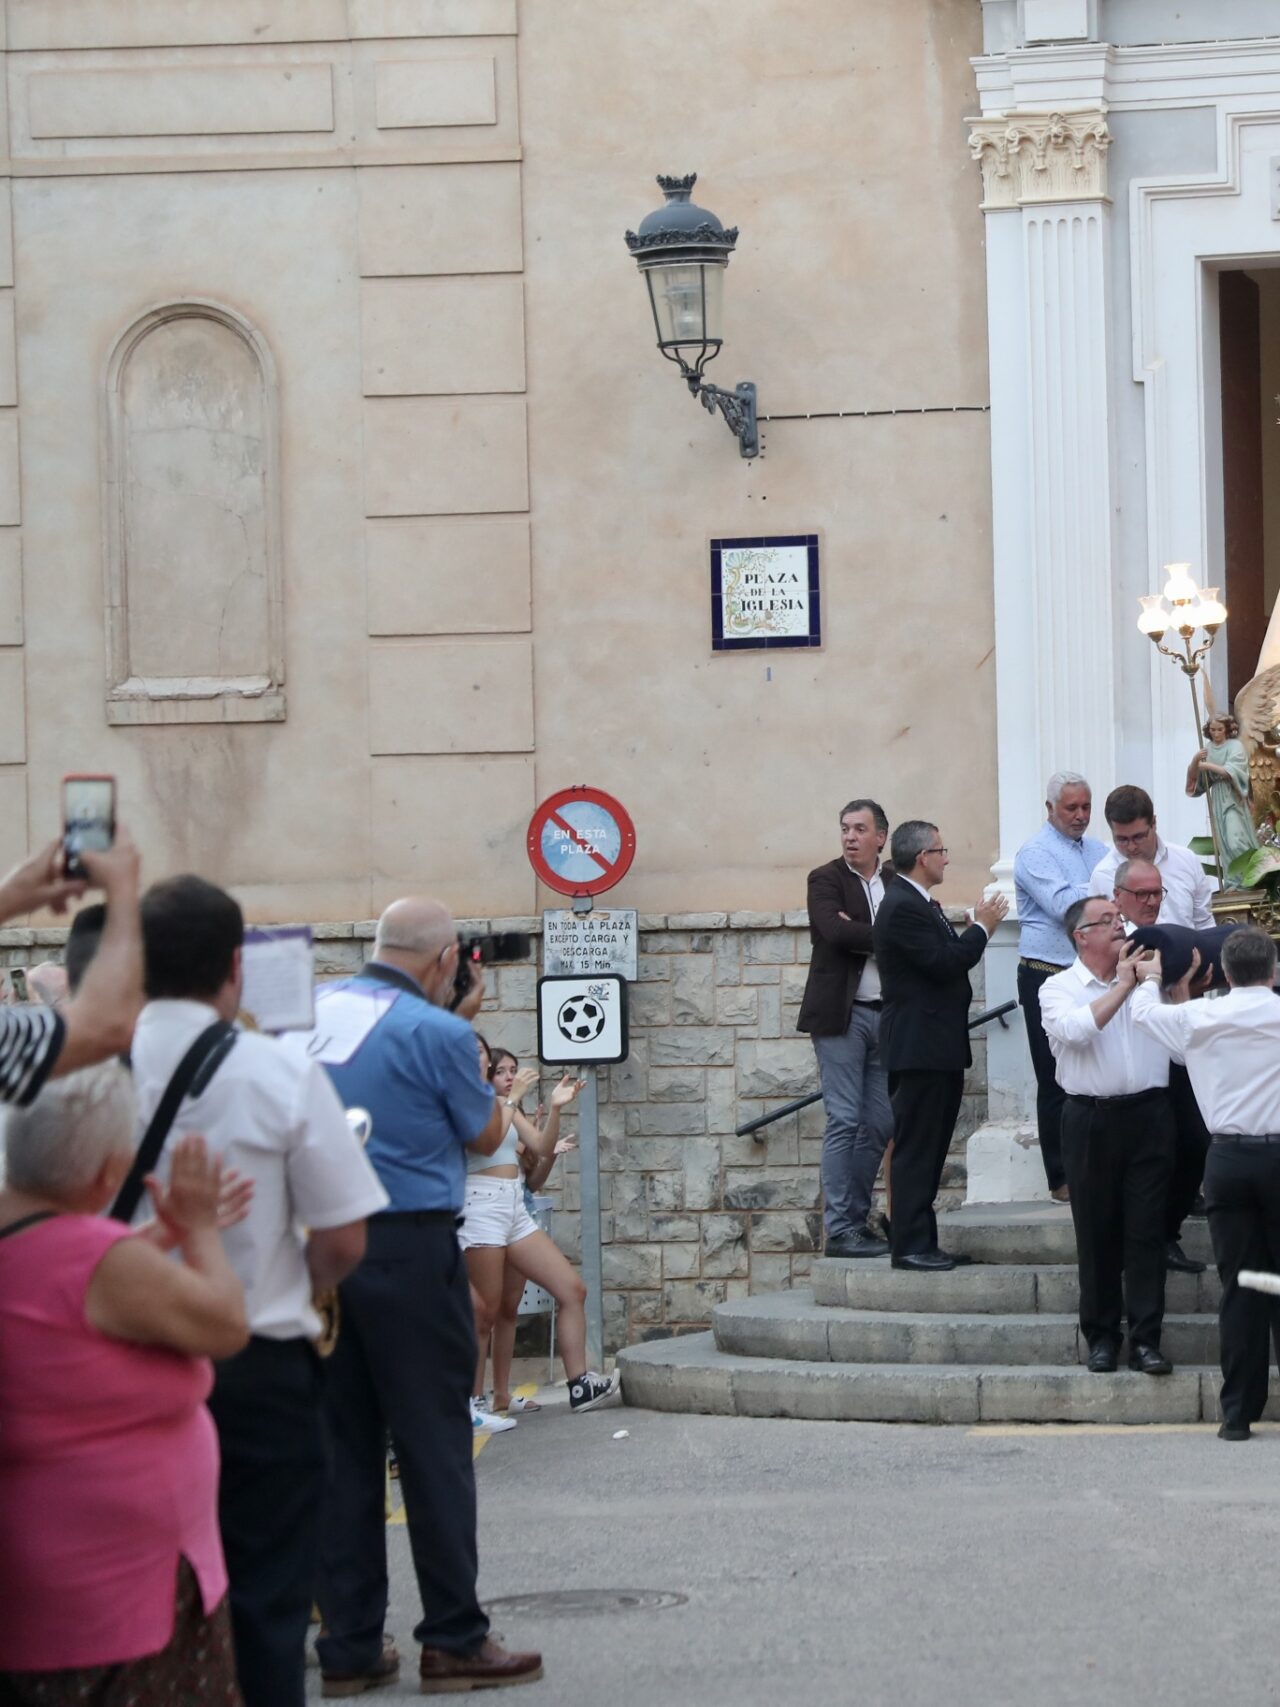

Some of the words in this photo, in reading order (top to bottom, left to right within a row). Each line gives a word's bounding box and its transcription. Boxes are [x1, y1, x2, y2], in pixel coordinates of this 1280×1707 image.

[745, 573, 799, 584] PLAZA
[750, 588, 765, 597] DE
[771, 588, 786, 596] LA
[741, 599, 804, 612] IGLESIA
[553, 829, 571, 840] EN
[576, 829, 607, 840] ESTA
[560, 844, 600, 855] PLAZA
[548, 921, 558, 931] EN
[560, 921, 577, 931] TODA
[582, 921, 594, 930] LA
[600, 921, 631, 930] PLAZA
[550, 934, 579, 944] EXCEPTO
[584, 934, 617, 943] CARGA
[623, 934, 629, 944] Y
[563, 947, 608, 957] DESCARGA
[580, 960, 590, 969] 15
